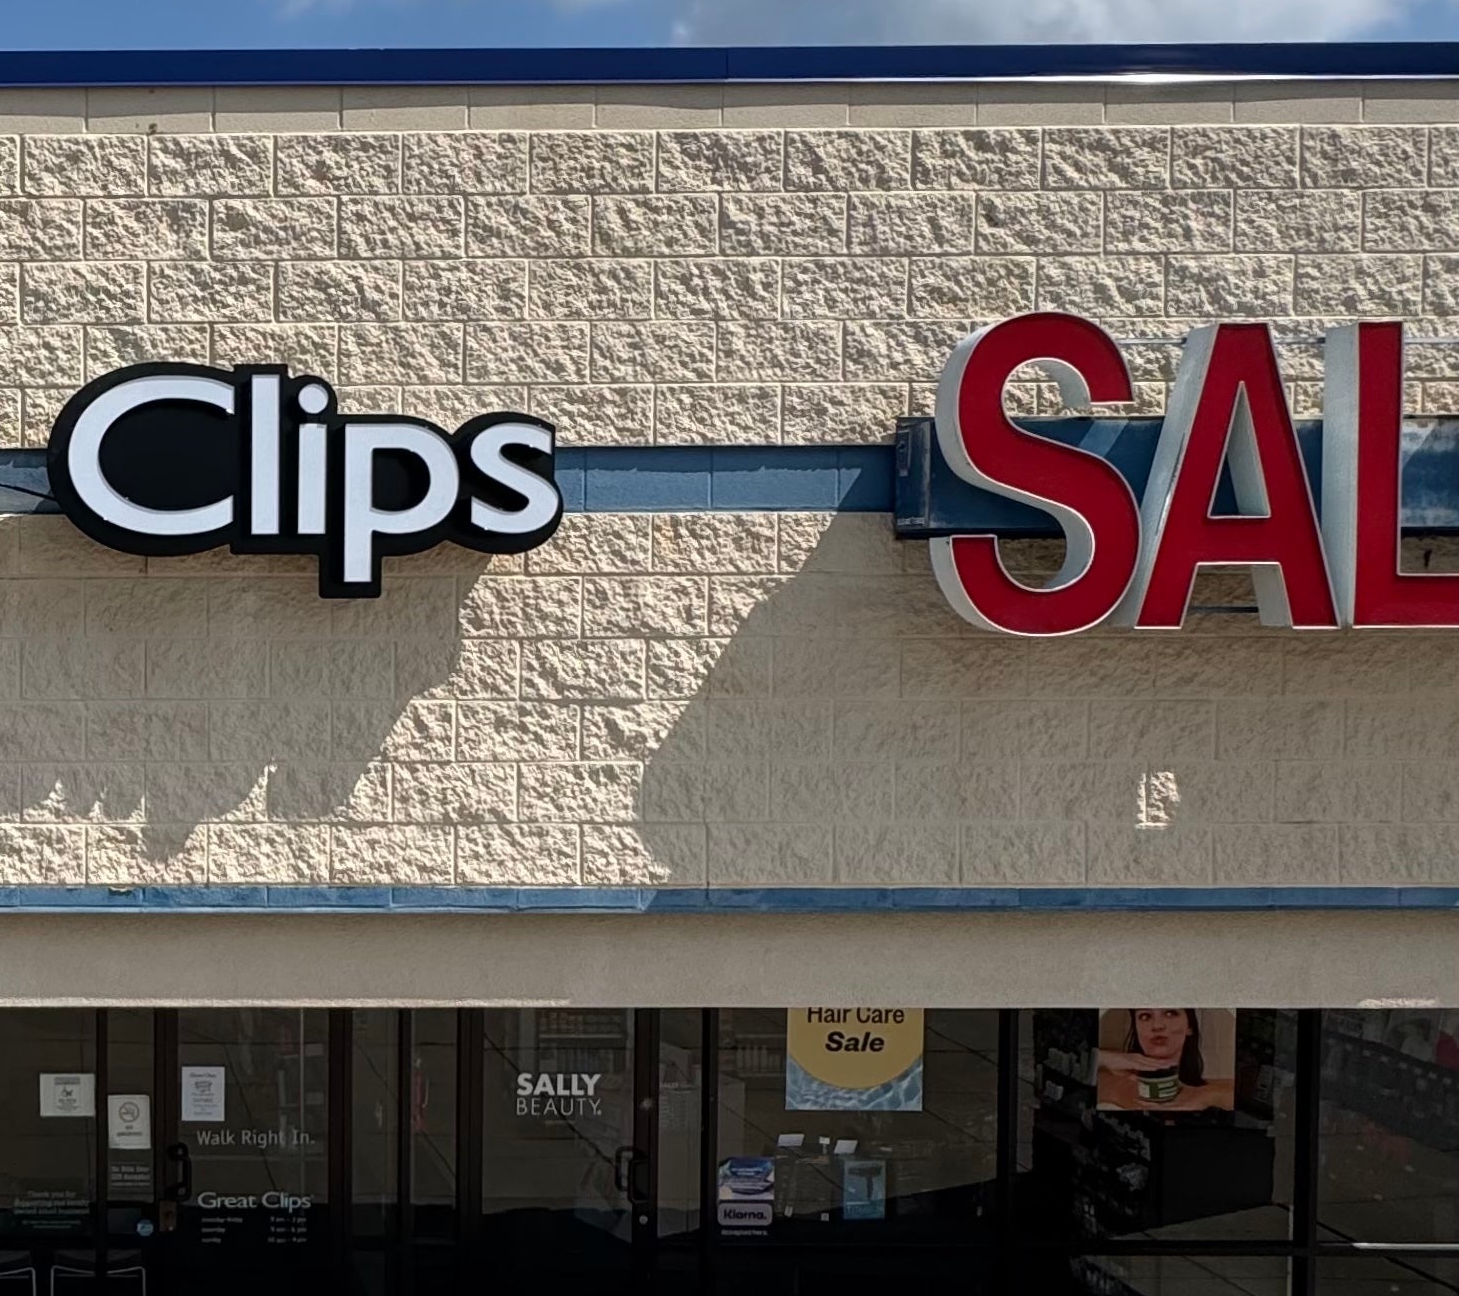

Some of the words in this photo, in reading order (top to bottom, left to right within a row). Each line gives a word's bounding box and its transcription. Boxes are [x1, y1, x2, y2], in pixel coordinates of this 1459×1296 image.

[67, 373, 563, 585] Clips
[937, 311, 1459, 638] SAL
[807, 1007, 851, 1024] Hair
[856, 1007, 905, 1024] Care
[825, 1031, 885, 1052] Sale
[516, 1072, 602, 1096] SALLY
[196, 1129, 236, 1146] Walk
[241, 1129, 287, 1150] Right
[292, 1129, 316, 1146] In.
[197, 1191, 257, 1209] Great
[261, 1190, 311, 1214] Clips
